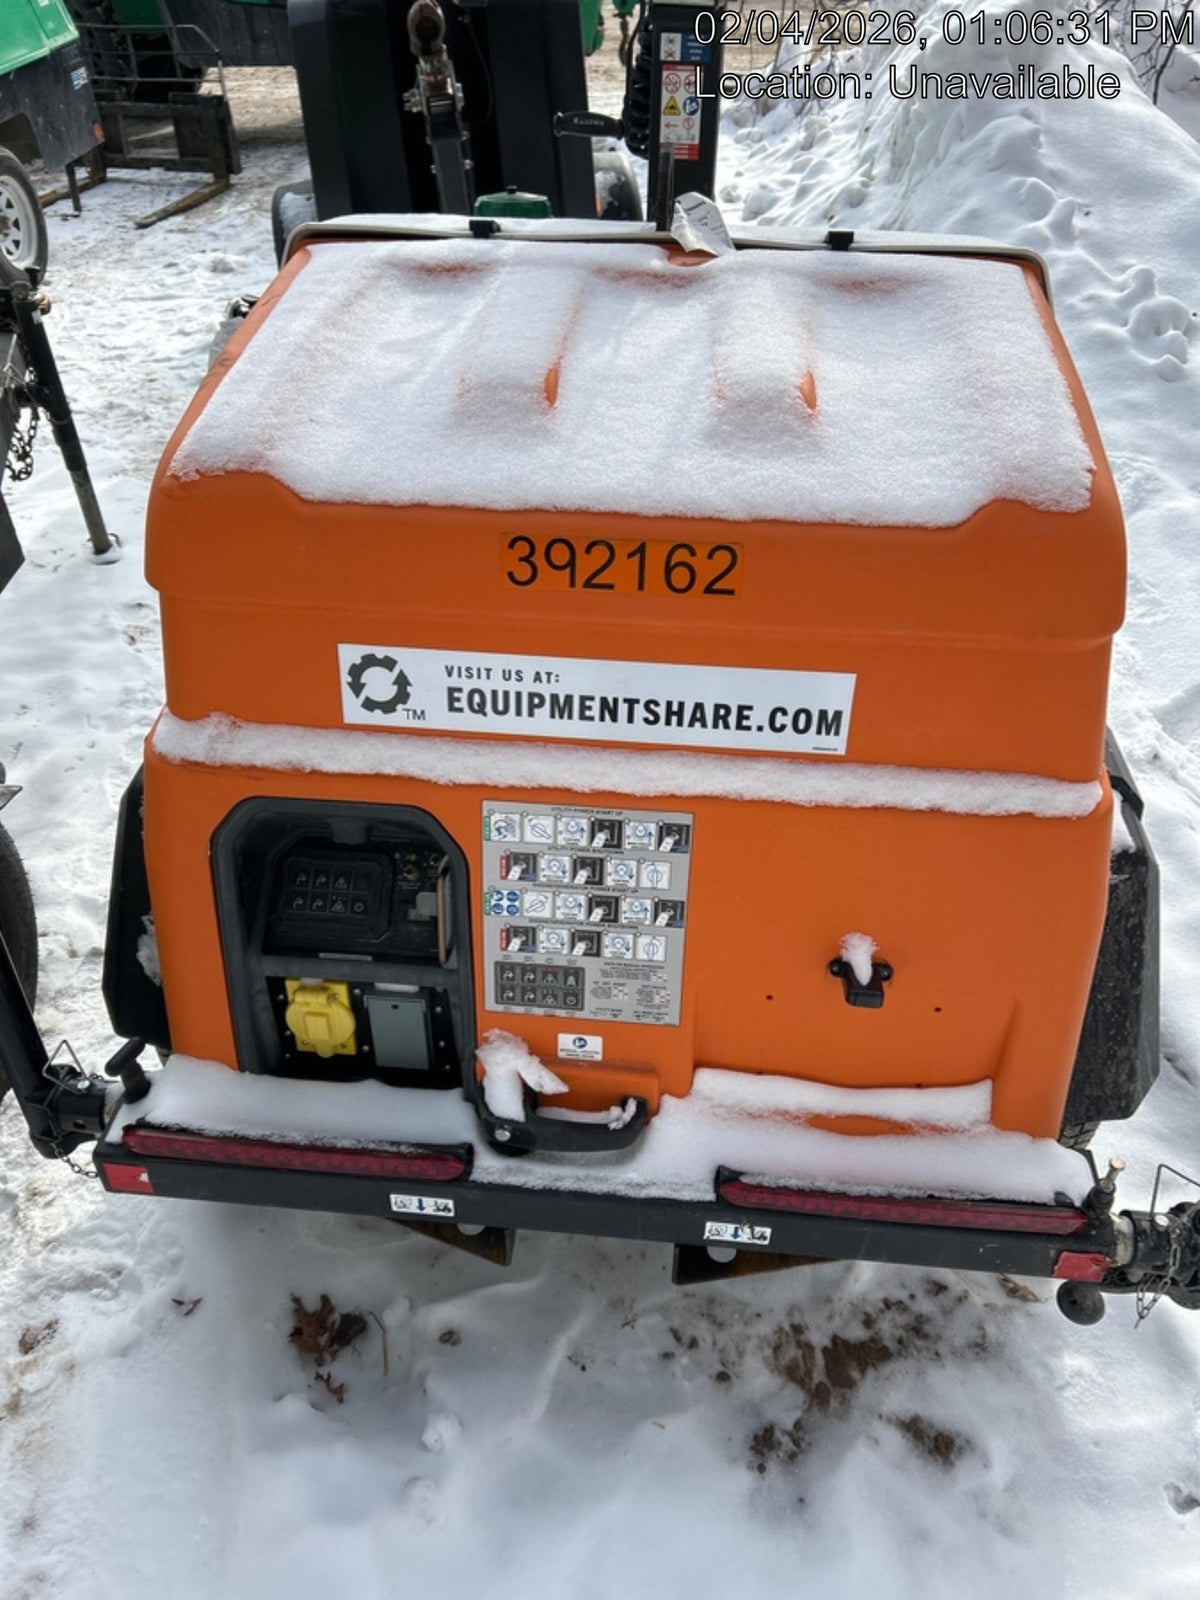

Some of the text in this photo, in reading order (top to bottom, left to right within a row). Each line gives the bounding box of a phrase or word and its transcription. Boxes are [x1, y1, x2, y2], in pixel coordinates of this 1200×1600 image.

[506, 534, 738, 596] 392162
[445, 665, 560, 685] VISIT US AT:
[402, 708, 426, 721] TM
[447, 686, 844, 737] EQUIPMENTSHARE.COM
